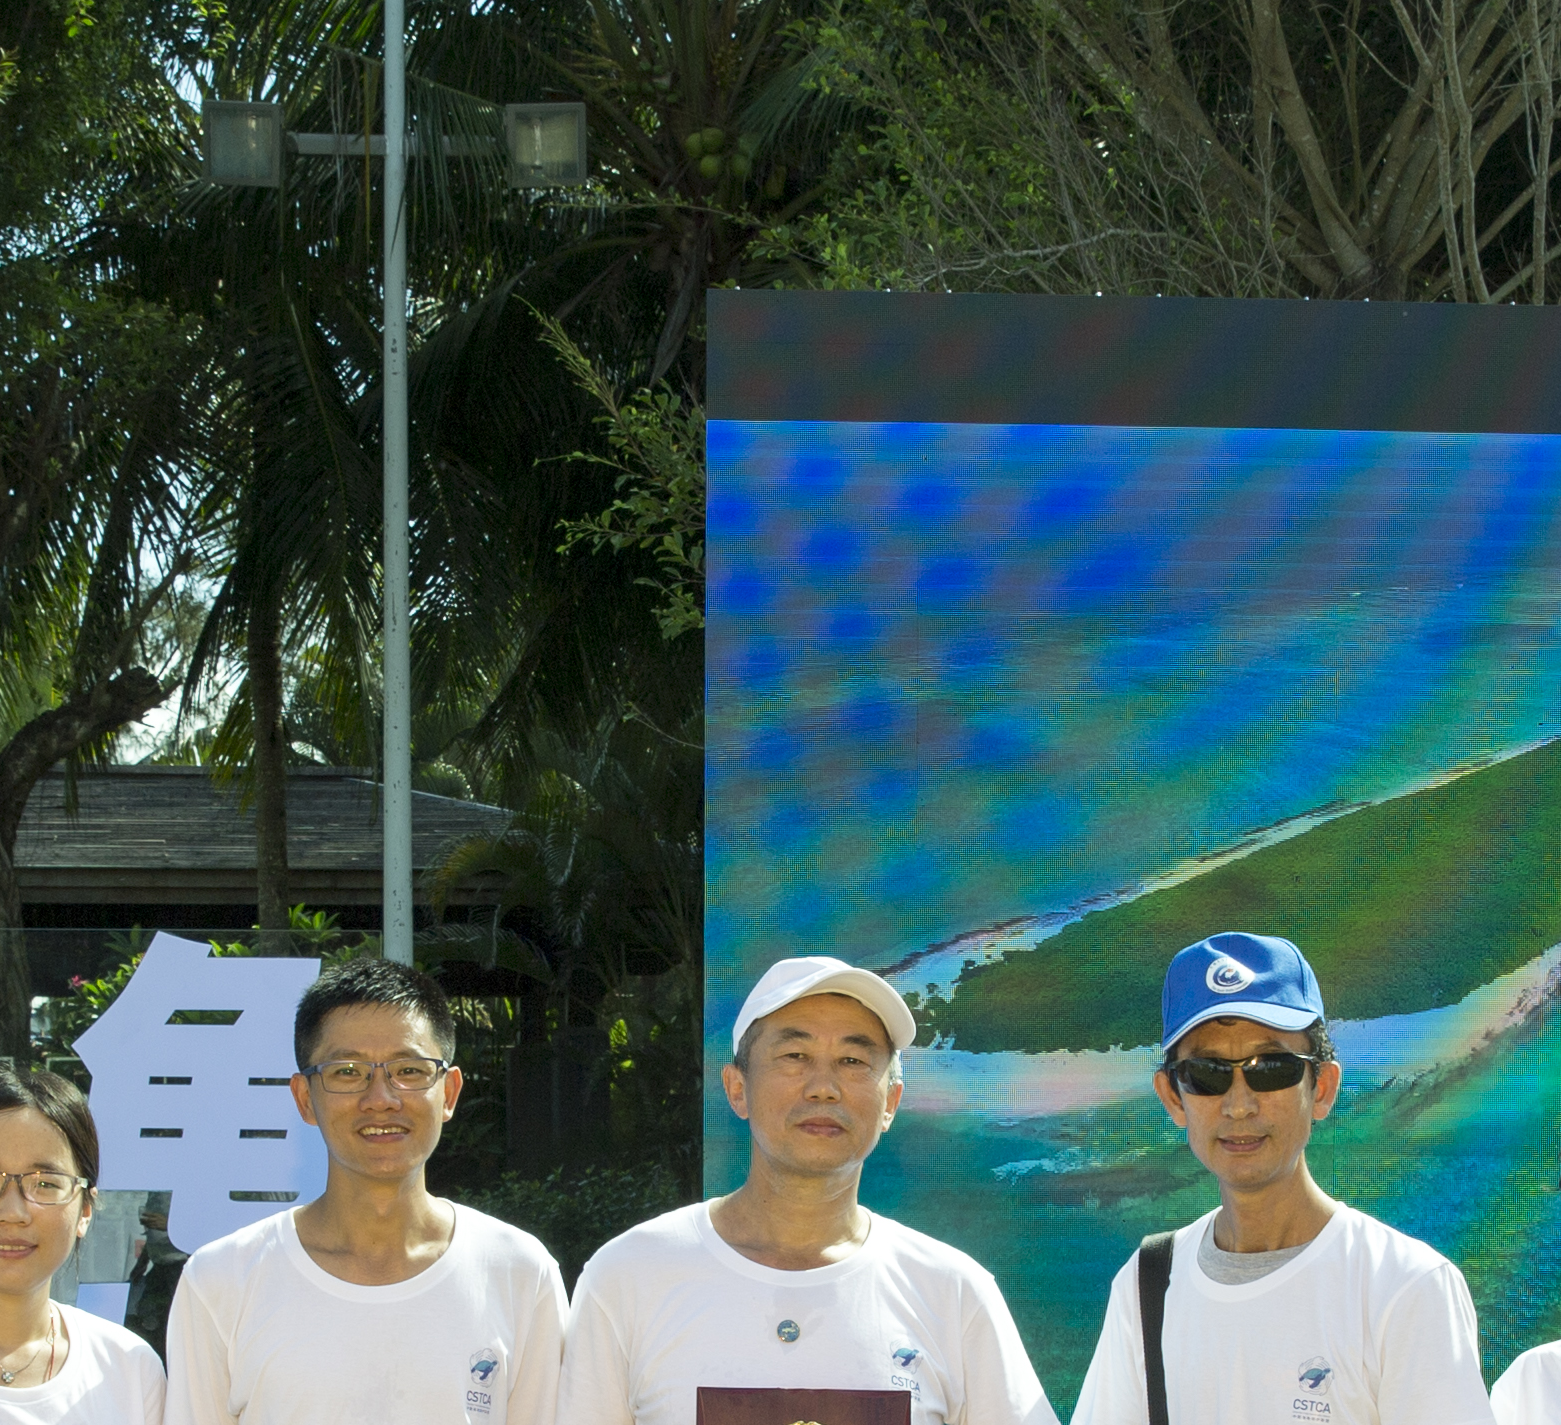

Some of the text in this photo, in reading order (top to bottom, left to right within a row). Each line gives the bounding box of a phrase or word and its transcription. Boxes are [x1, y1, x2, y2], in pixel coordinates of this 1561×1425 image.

[891, 1374, 921, 1392] CSTCA
[466, 1390, 491, 1406] CSTCA
[1293, 1398, 1331, 1414] CSTCA
